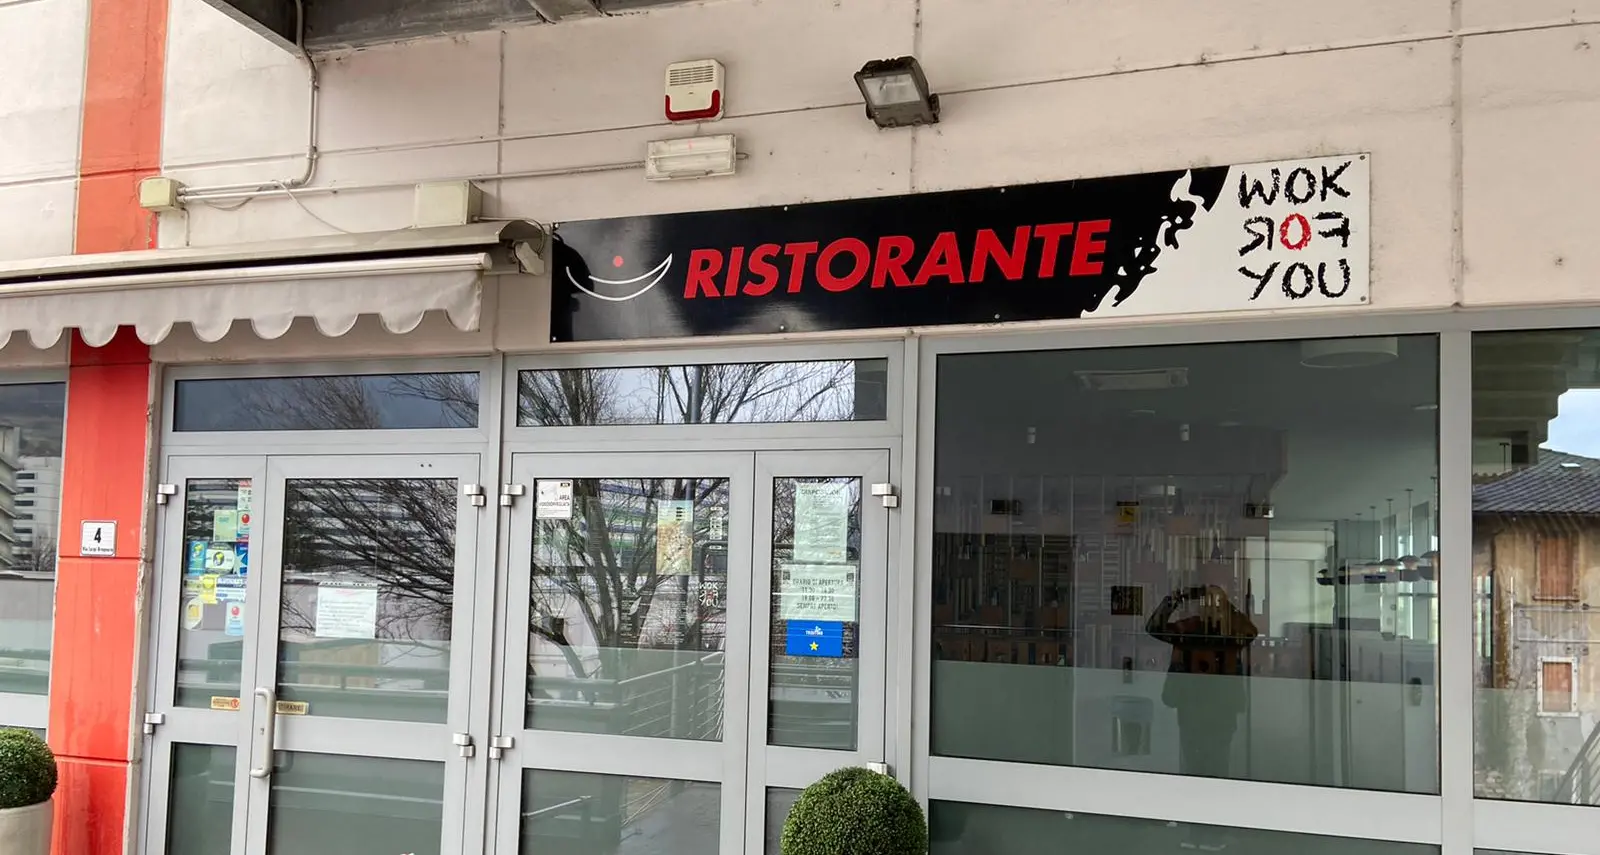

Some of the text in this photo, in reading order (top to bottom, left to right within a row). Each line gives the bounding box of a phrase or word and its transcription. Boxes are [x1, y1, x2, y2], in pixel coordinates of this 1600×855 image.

[1238, 161, 1352, 208] WOK
[683, 219, 1111, 299] RISTORANTE
[1238, 259, 1351, 301] YOU
[94, 527, 102, 544] 4
